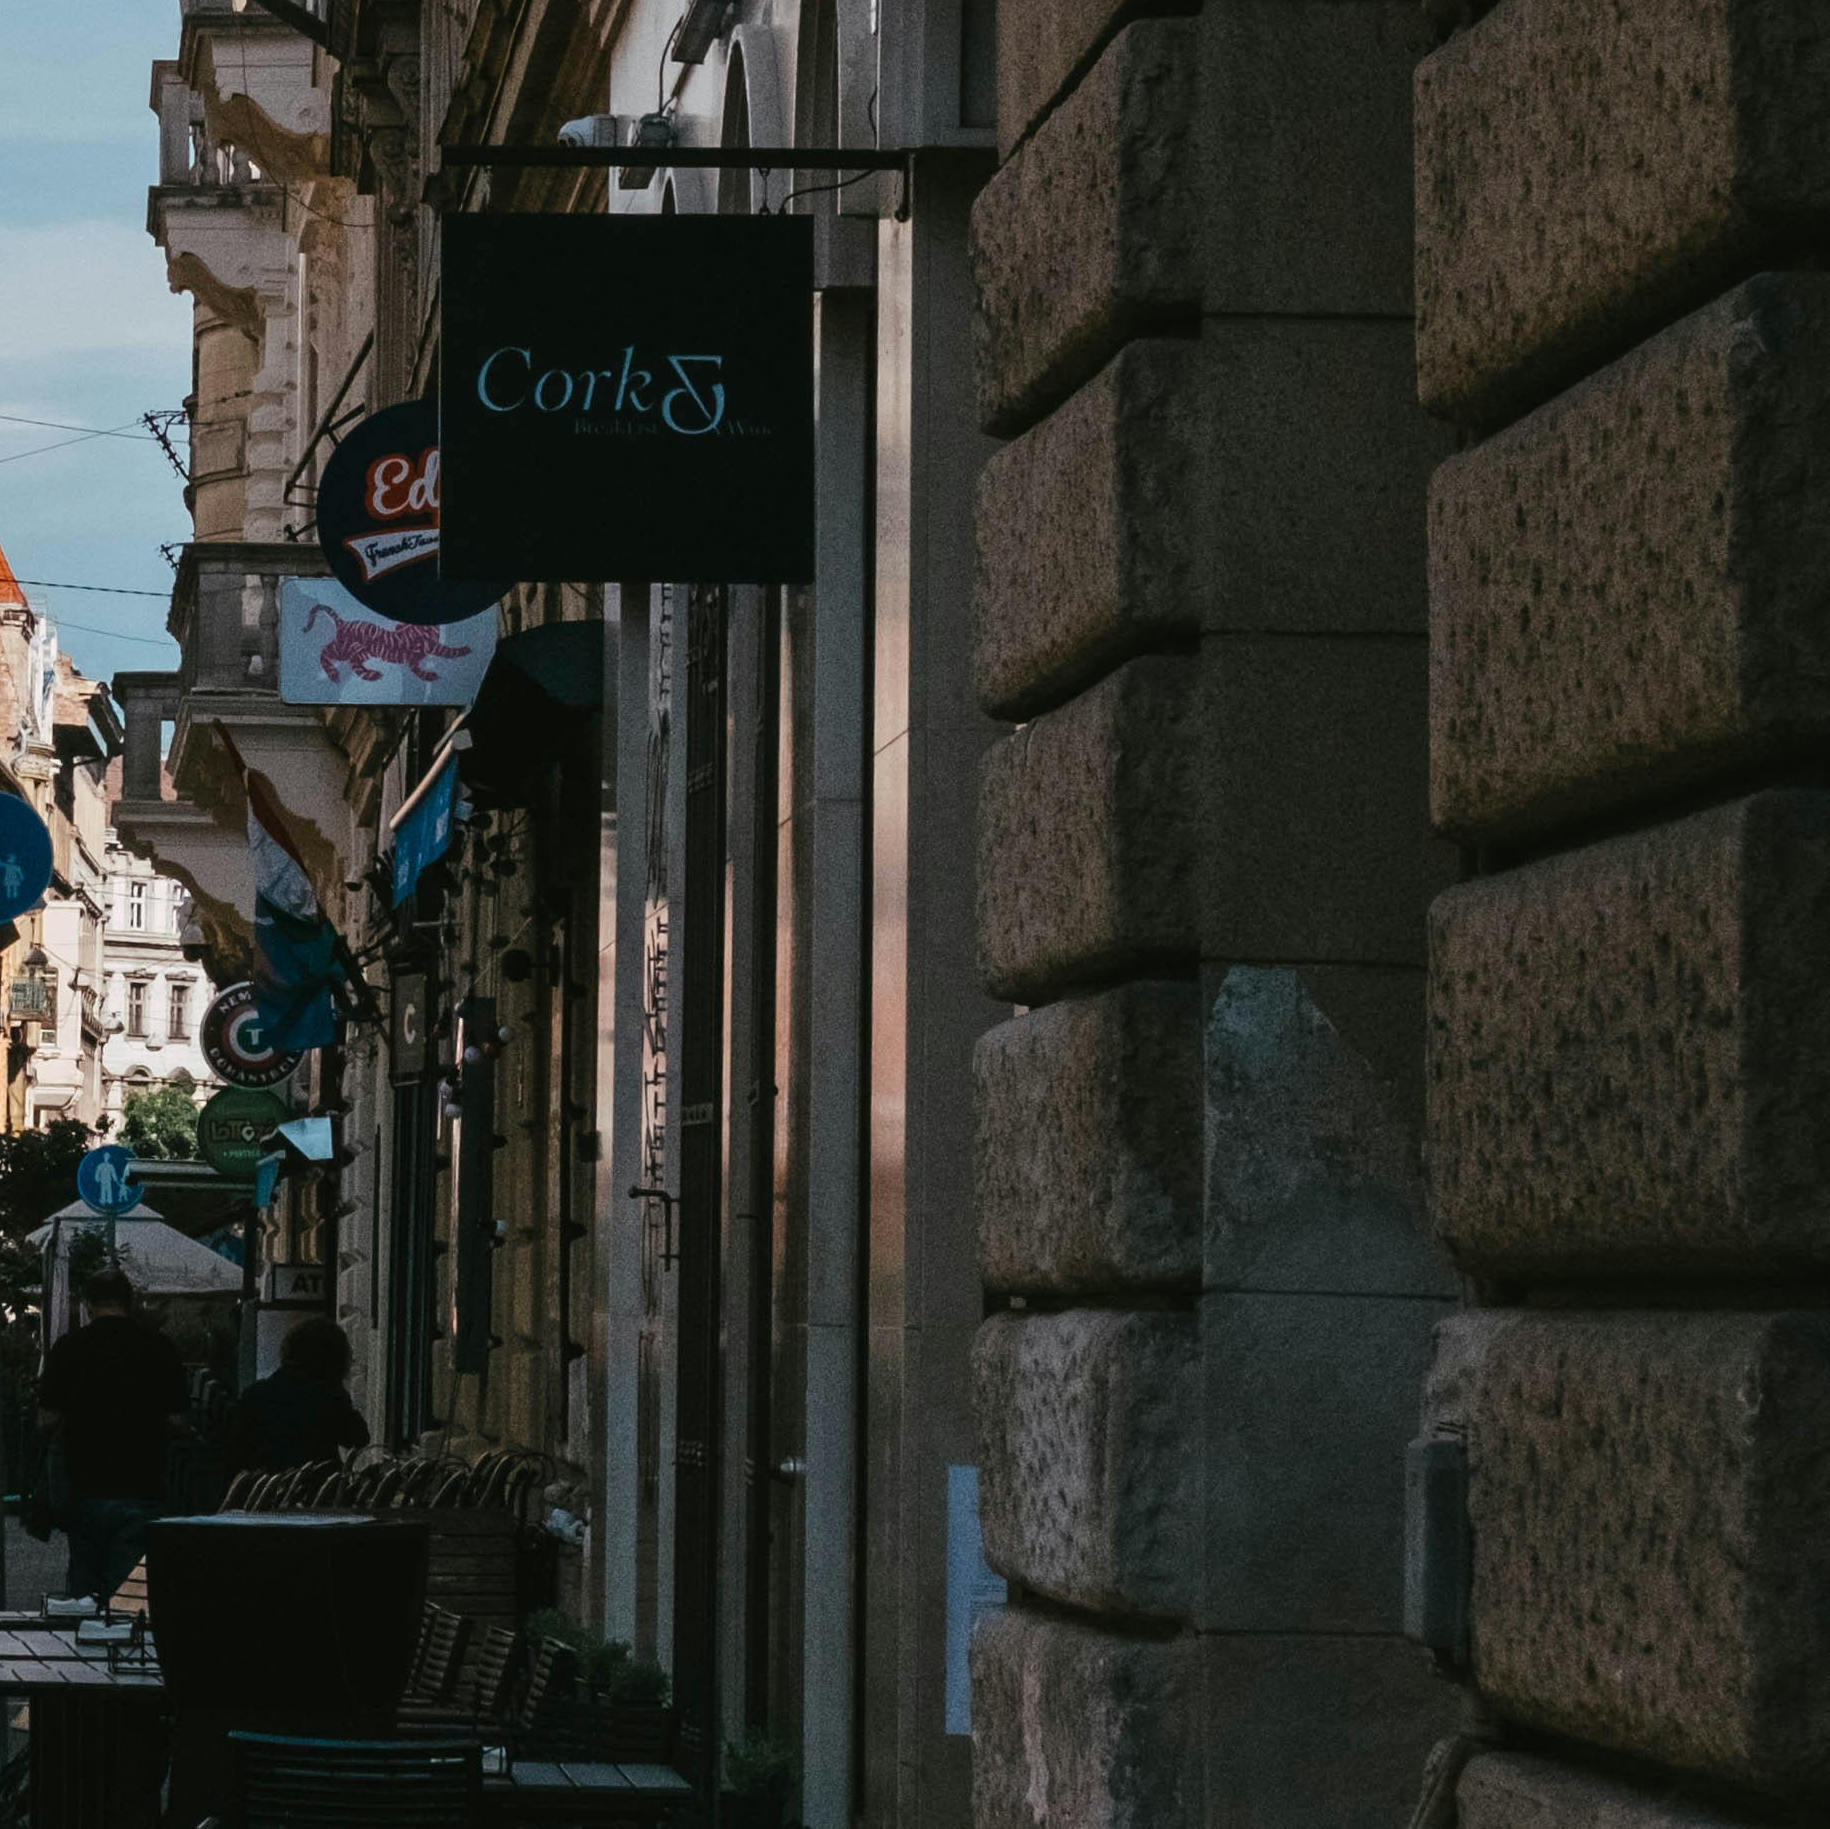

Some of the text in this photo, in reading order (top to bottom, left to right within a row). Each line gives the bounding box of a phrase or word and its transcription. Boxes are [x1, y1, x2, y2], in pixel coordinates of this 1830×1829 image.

[372, 449, 439, 515] Ed
[219, 991, 252, 1014] NEM
[292, 1273, 325, 1293] AT
